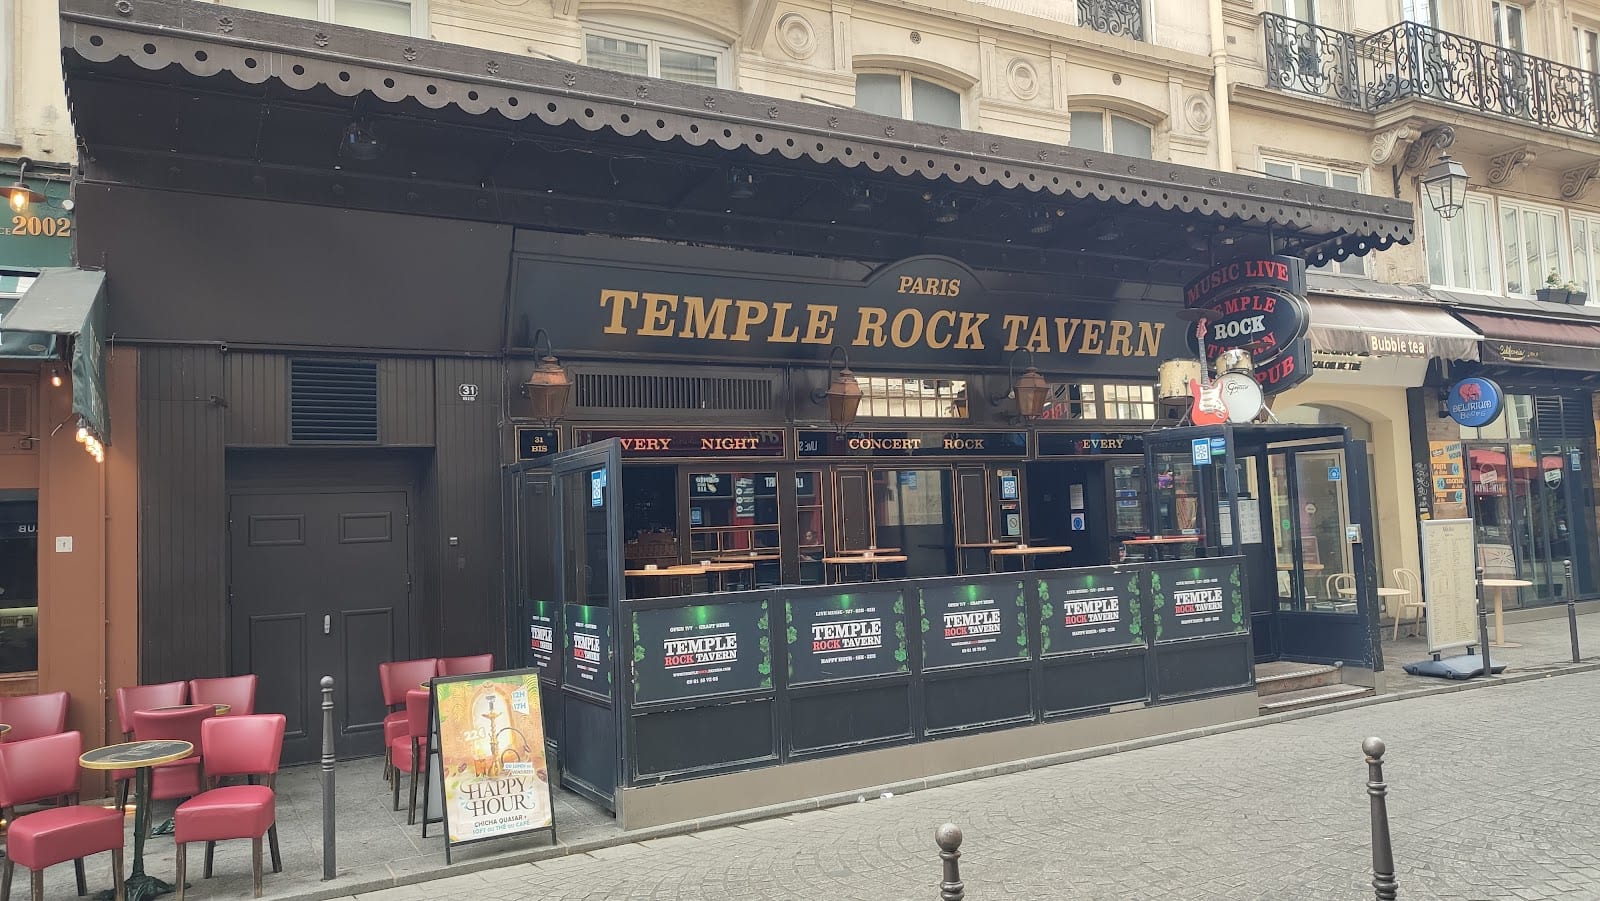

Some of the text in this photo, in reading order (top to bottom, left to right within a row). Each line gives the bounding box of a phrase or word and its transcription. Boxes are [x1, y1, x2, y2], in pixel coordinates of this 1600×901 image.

[12, 215, 71, 237] 2002
[898, 275, 961, 297] PARIS
[1187, 260, 1289, 305] MUSIC LIVE
[1206, 295, 1277, 324] EMPLE
[600, 289, 1166, 357] TEMPLE ROCK TAVERN
[1214, 315, 1266, 341] ROCK
[1371, 335, 1406, 353] Bubble
[1408, 339, 1425, 355] tea
[1255, 355, 1295, 384] PUB
[462, 385, 475, 396] 31
[1452, 400, 1492, 413] DELIRIUM
[534, 436, 543, 444] 31
[620, 438, 672, 450] VERY
[701, 438, 759, 450] NIGHT
[849, 438, 985, 450] CONCERT ROCK
[1082, 439, 1124, 449] EVERY
[531, 445, 548, 453] BIS
[1174, 589, 1223, 606] TEMPLE
[1064, 598, 1119, 615] TEMPLE
[1175, 601, 1223, 614] ROCK TAVERN
[943, 611, 1000, 629] TEMPLE
[1065, 611, 1119, 625] ROCK TAVERN
[531, 626, 552, 642] TEMPLE
[812, 620, 882, 641] TEMPLE
[944, 623, 1000, 637] ROCK TAVERN
[573, 634, 600, 652] TEMPLE
[663, 635, 738, 656] TEMPLE
[812, 635, 881, 651] ROCK TAVERN
[664, 649, 738, 667] ROCK TAVERN
[513, 690, 526, 699] 12H
[460, 776, 527, 801] HAPPY
[466, 795, 535, 818] HOUR
[474, 819, 498, 828] CHICHA
[499, 814, 523, 824] QUASAR
